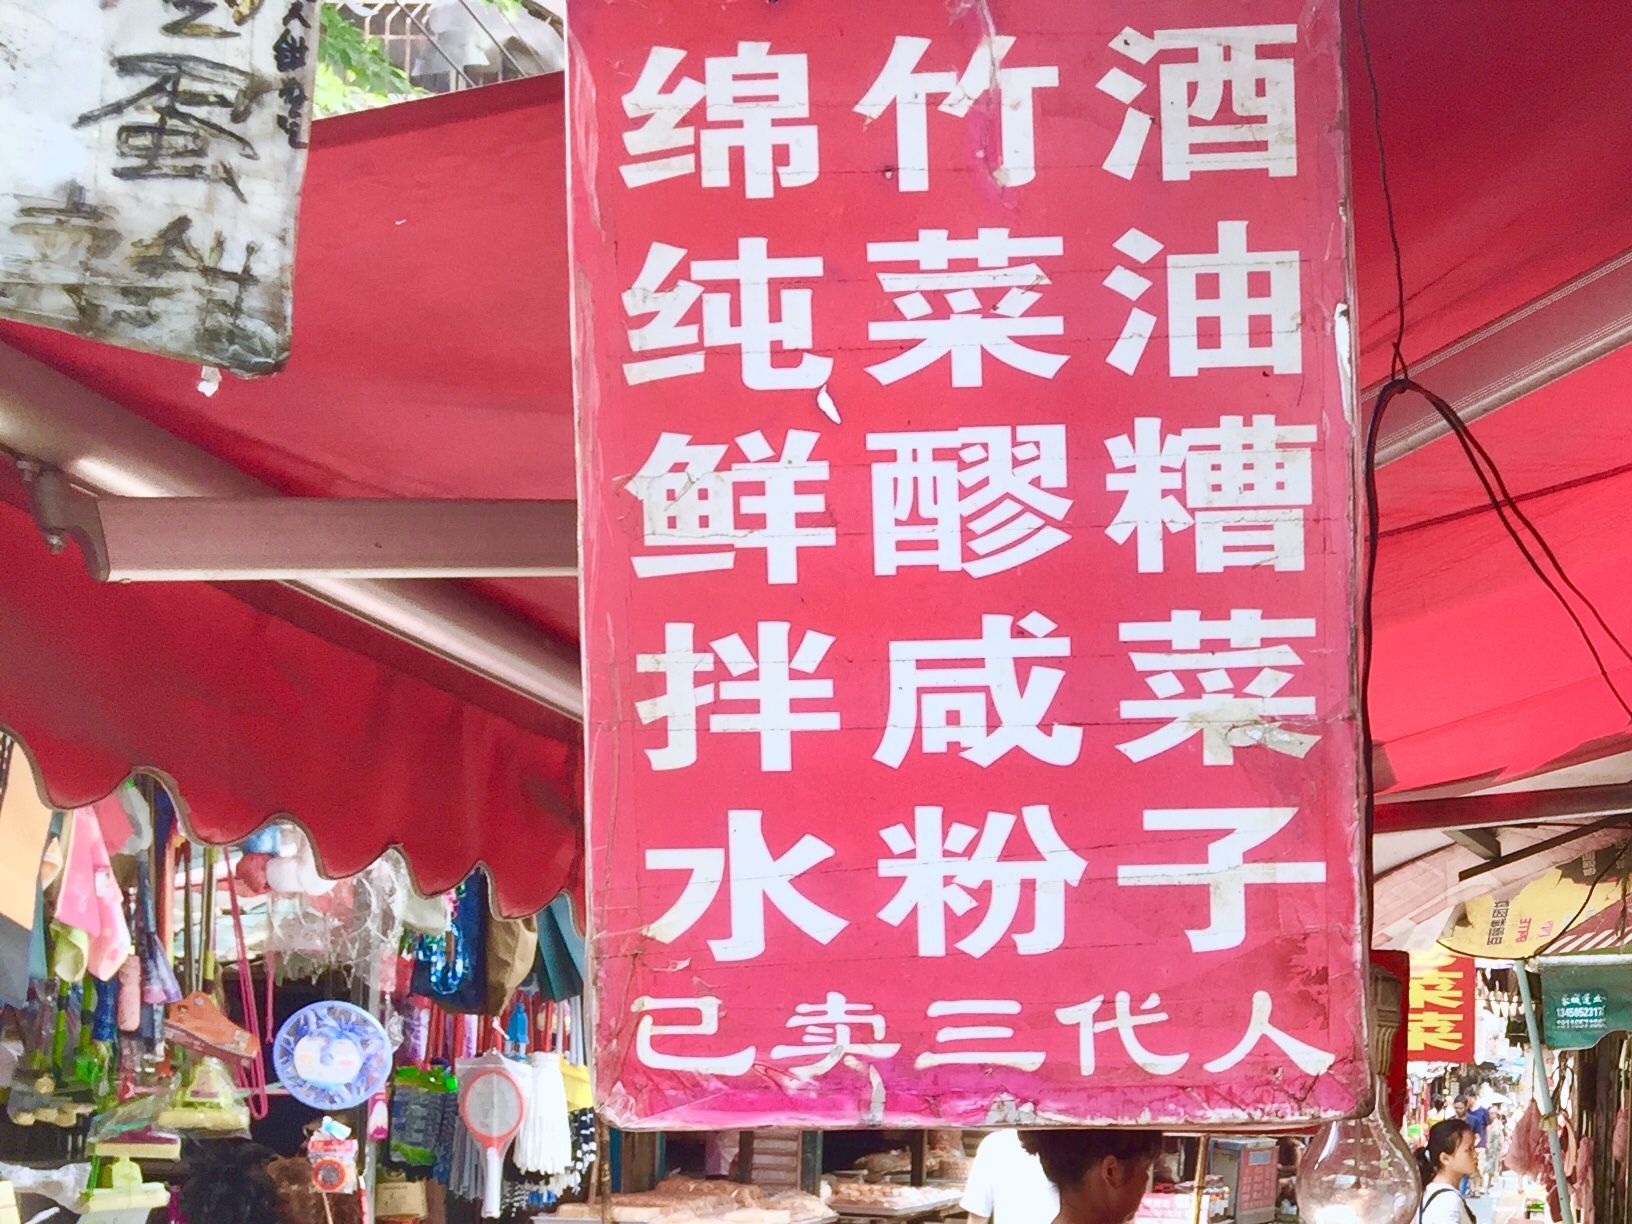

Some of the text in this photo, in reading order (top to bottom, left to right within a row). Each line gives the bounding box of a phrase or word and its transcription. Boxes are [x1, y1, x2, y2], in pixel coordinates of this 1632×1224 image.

[620, 24, 1300, 199] 绵竹酒
[621, 219, 1306, 393] 纯菜油
[624, 415, 1316, 585] 鲜醪糟
[635, 608, 1322, 774] 拌咸菜
[643, 804, 1328, 963] 水粉子
